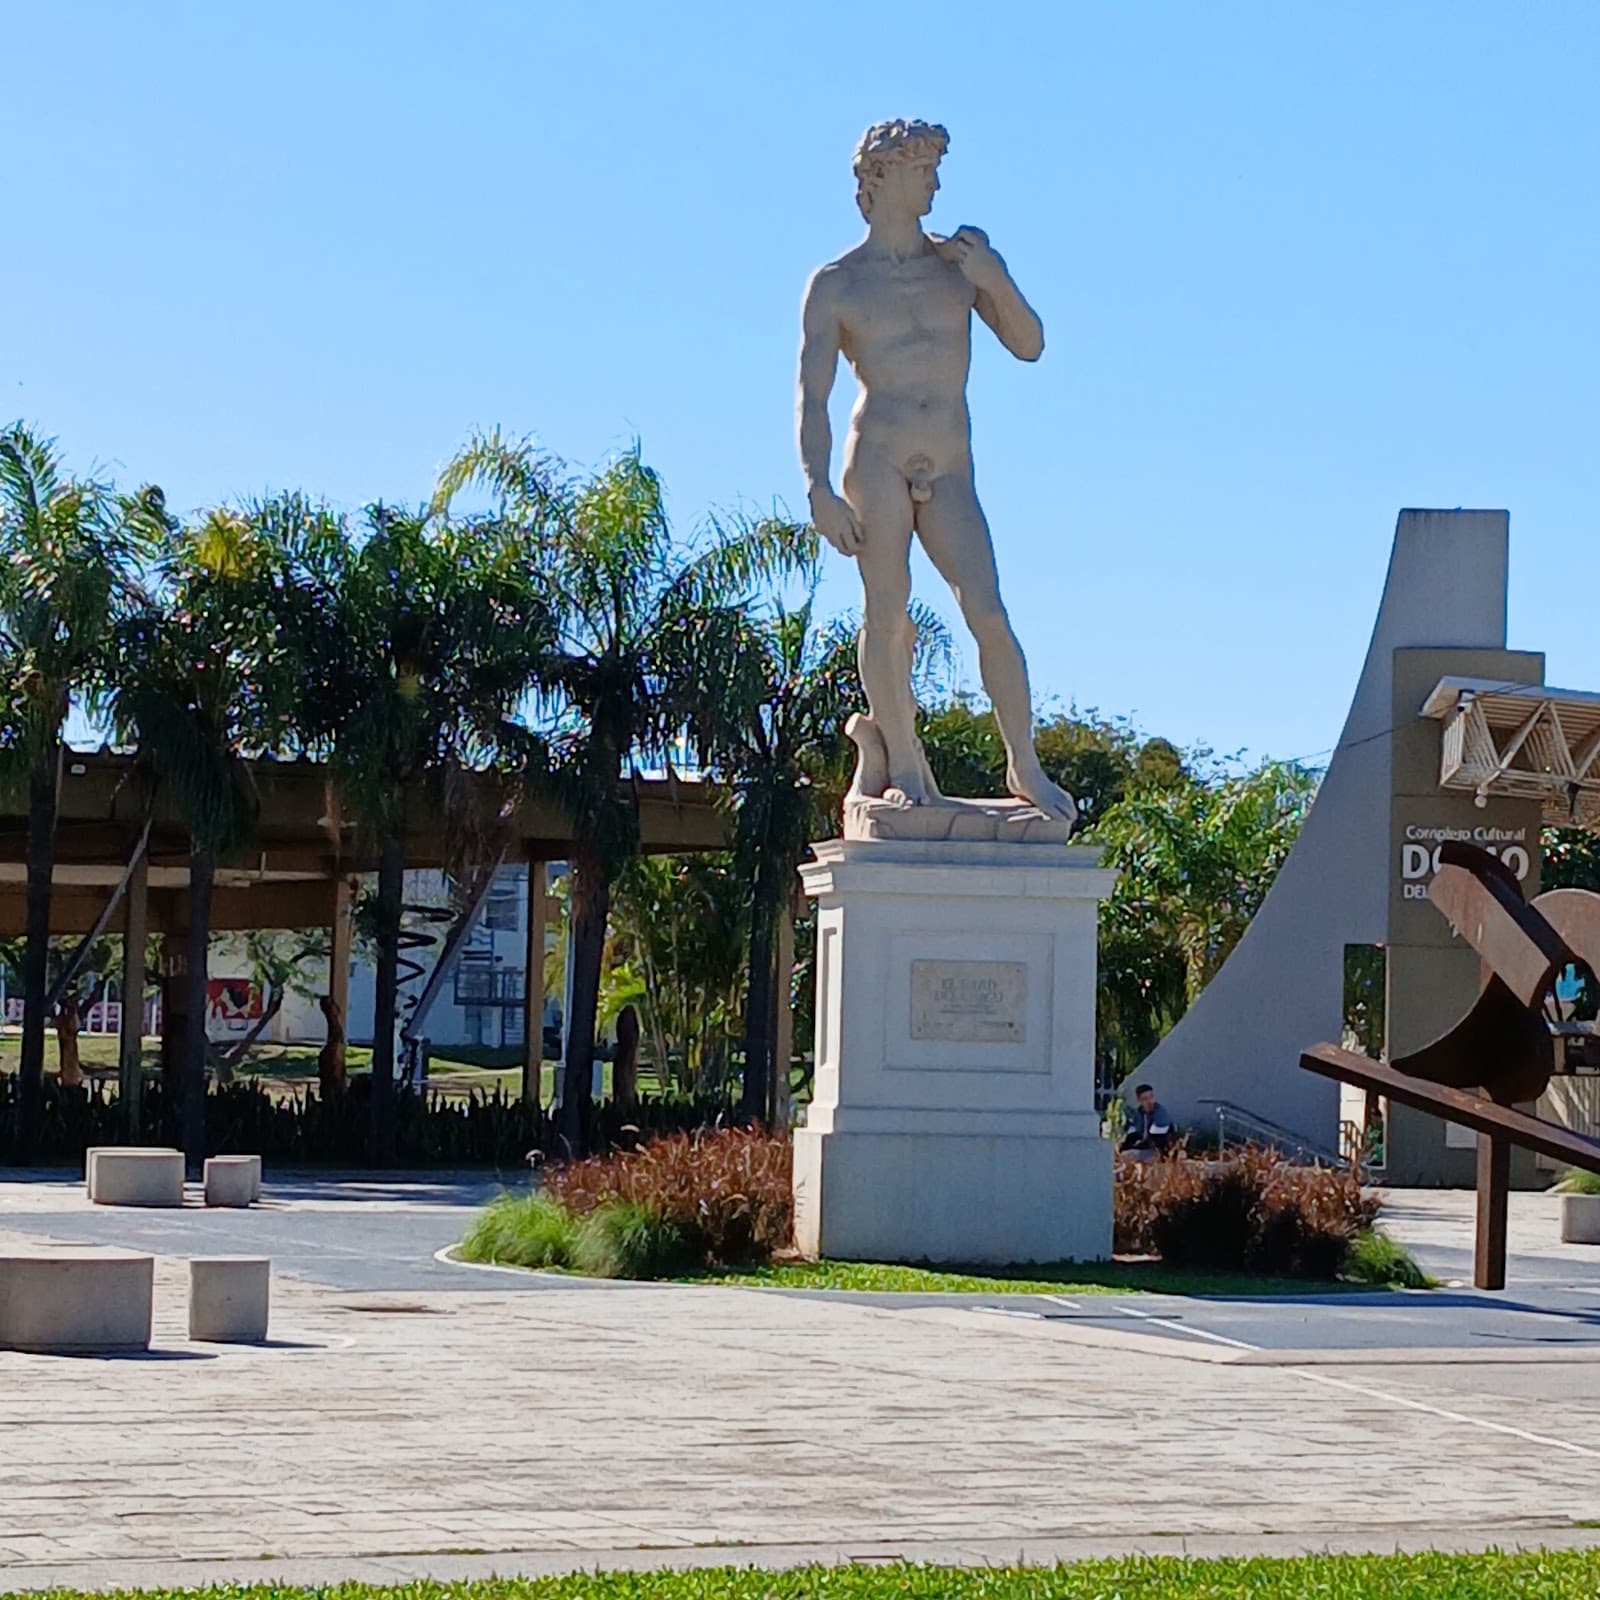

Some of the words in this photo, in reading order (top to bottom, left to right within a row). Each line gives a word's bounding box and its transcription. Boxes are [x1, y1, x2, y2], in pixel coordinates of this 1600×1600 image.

[1405, 825, 1471, 842] Complejo
[1473, 827, 1526, 841] Cultural
[1402, 843, 1529, 881] DO
